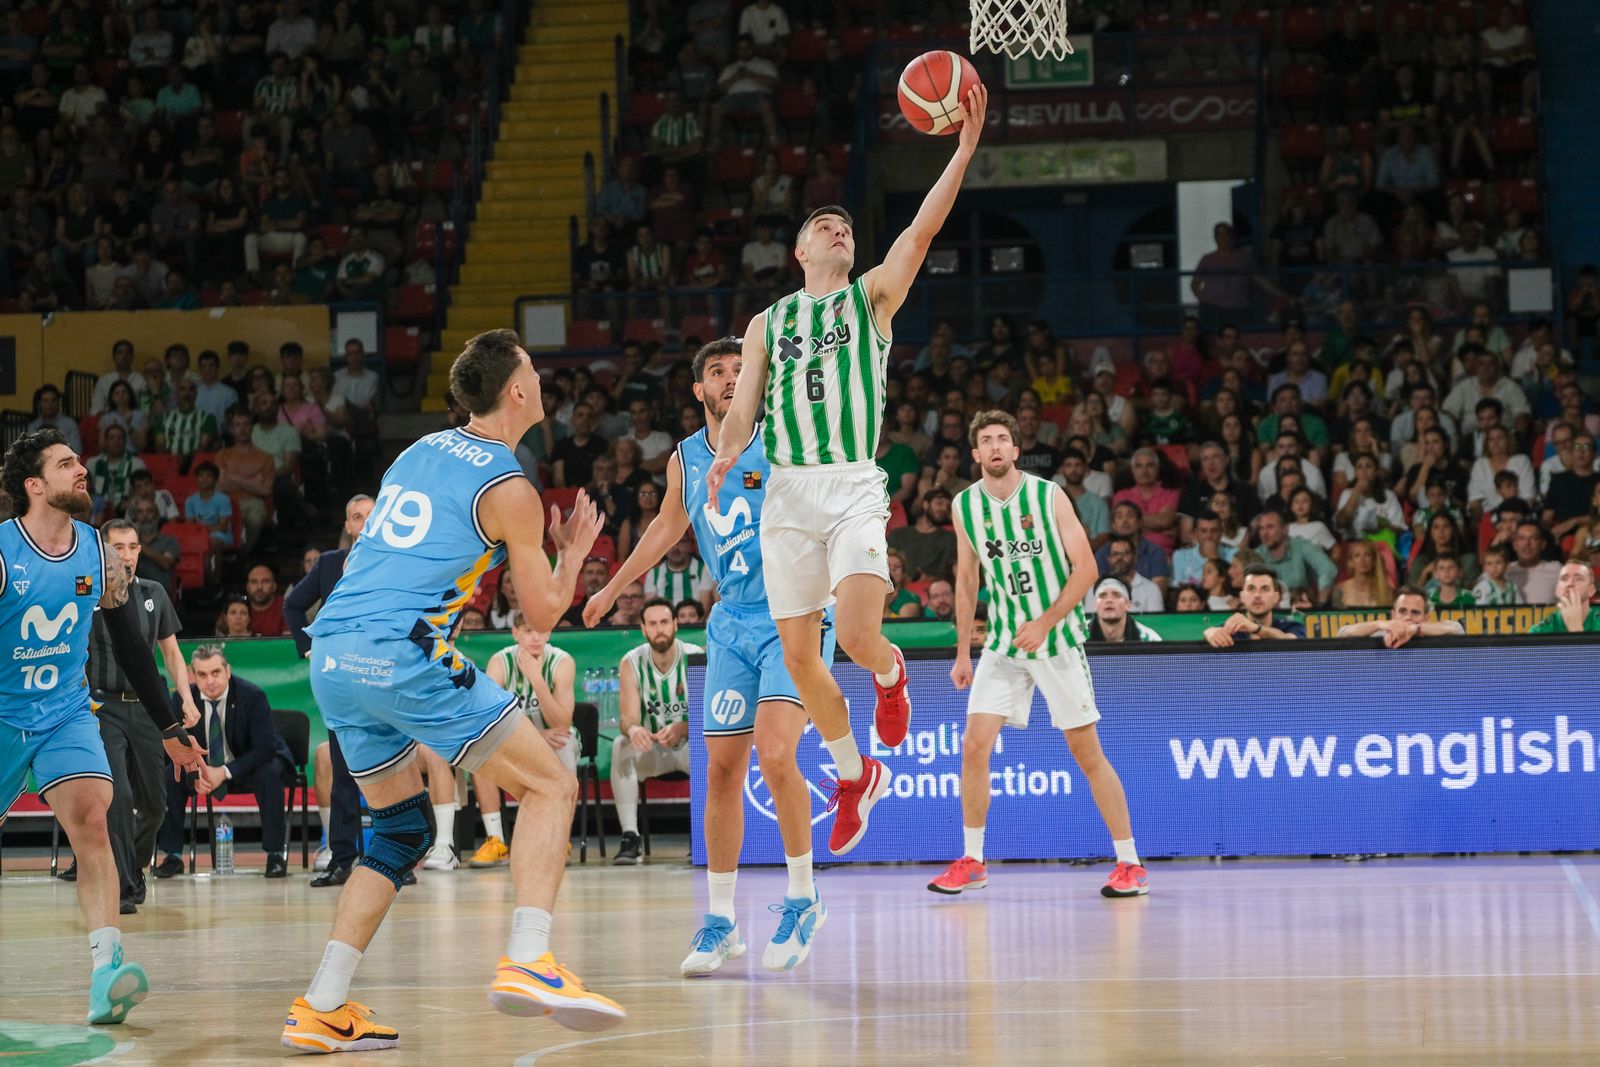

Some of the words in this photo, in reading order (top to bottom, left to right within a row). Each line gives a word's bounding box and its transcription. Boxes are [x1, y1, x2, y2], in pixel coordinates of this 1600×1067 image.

[1009, 102, 1125, 126] SEVILLA
[806, 369, 825, 401] 6
[367, 484, 433, 549] 19
[729, 550, 750, 575] 4
[1008, 570, 1033, 596] 12
[12, 642, 71, 660] Estudiantes
[20, 664, 59, 690] 10
[714, 689, 743, 725] hp
[869, 722, 1004, 765] Engli
[880, 762, 1072, 799] onnction
